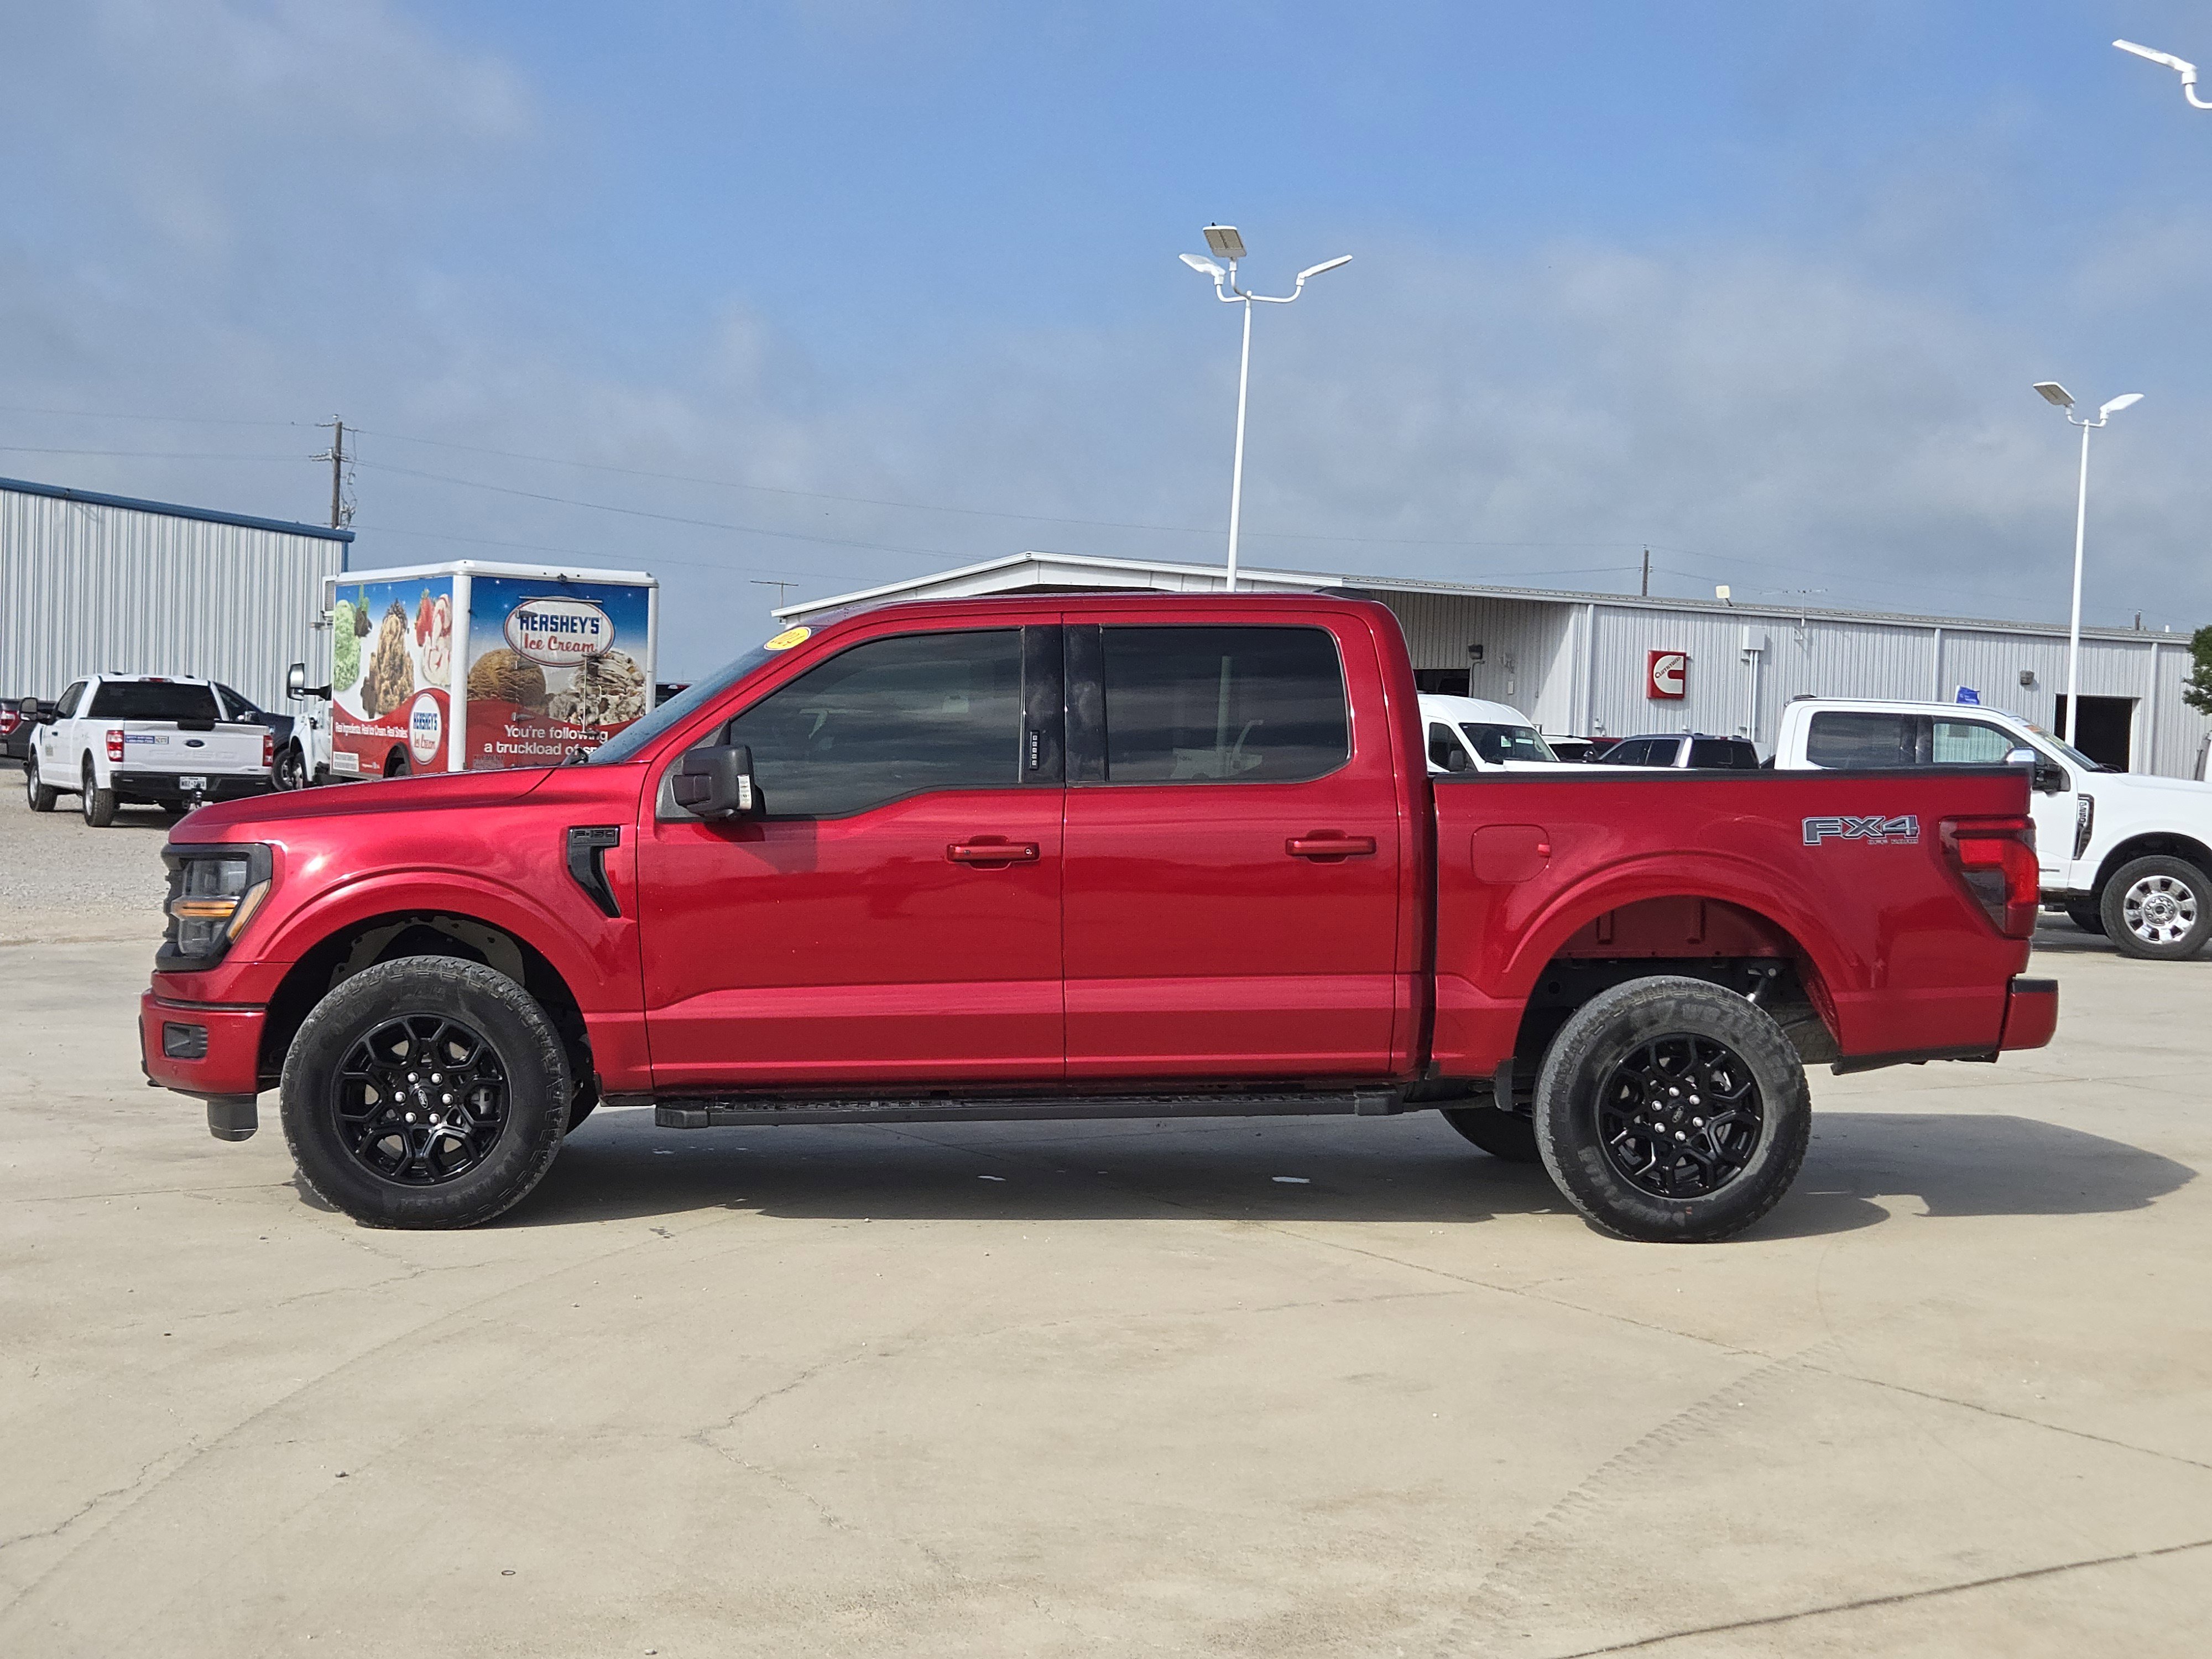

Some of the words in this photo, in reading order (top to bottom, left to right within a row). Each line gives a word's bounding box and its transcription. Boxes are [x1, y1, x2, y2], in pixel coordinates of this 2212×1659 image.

[520, 614, 599, 635] HERSHEY'S
[524, 633, 545, 650] Ice
[548, 635, 596, 653] Cream
[1655, 656, 1681, 679] Cummins
[504, 724, 546, 739] You're
[483, 742, 493, 753] a
[496, 741, 562, 755] truckload
[574, 830, 615, 838] F-150
[1802, 815, 1919, 846] FX4
